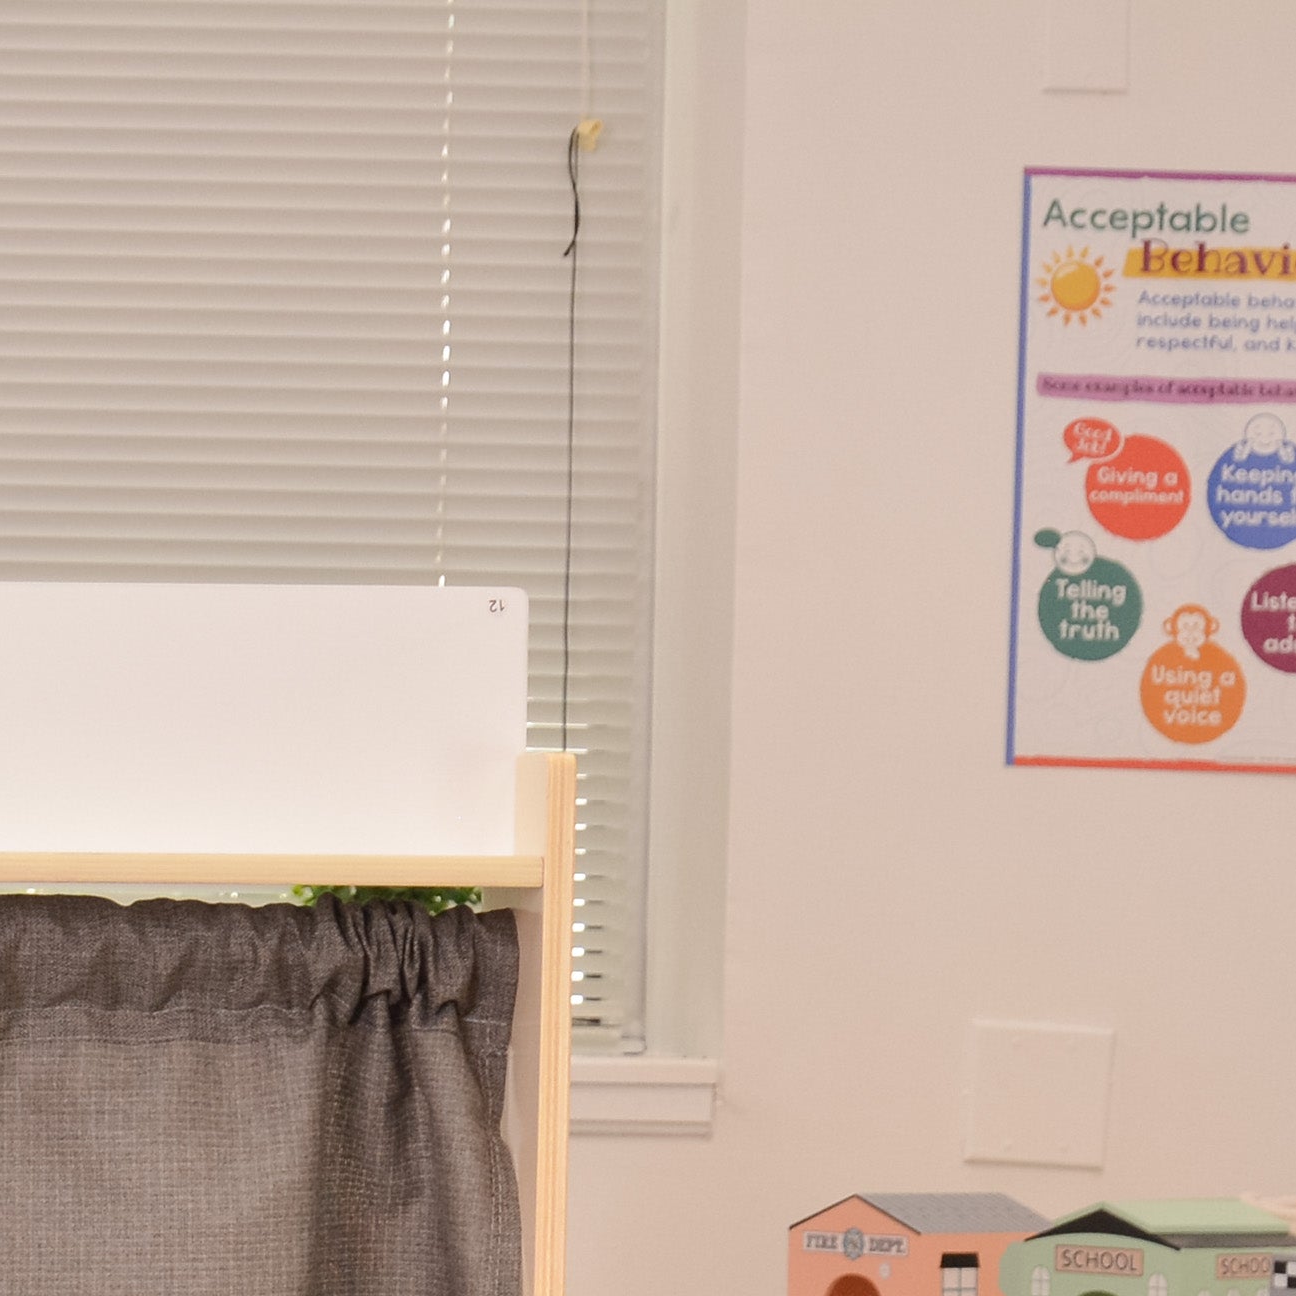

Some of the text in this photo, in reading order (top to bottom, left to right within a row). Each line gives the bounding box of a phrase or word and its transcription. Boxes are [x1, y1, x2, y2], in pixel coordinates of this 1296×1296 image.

[1043, 198, 1251, 238] Acceptable
[1141, 238, 1296, 275] Behavi
[1137, 290, 1241, 309] Acceptable
[1137, 312, 1296, 332] include being hel
[1244, 336, 1281, 350] and
[1097, 466, 1179, 490] Giving a
[1221, 463, 1296, 488] Keepin
[1088, 489, 1185, 506] compliment
[1215, 484, 1284, 505] hands
[1055, 578, 1127, 607] Telling
[489, 599, 505, 613] 12
[1070, 599, 1110, 620] the
[1059, 619, 1120, 640] truth
[1263, 634, 1296, 653] ad
[1151, 664, 1236, 690] Using a
[1164, 685, 1221, 709] quiet
[1163, 706, 1223, 726] voice
[806, 1234, 838, 1250] FIRE
[1061, 1248, 1138, 1271] SCHOOL
